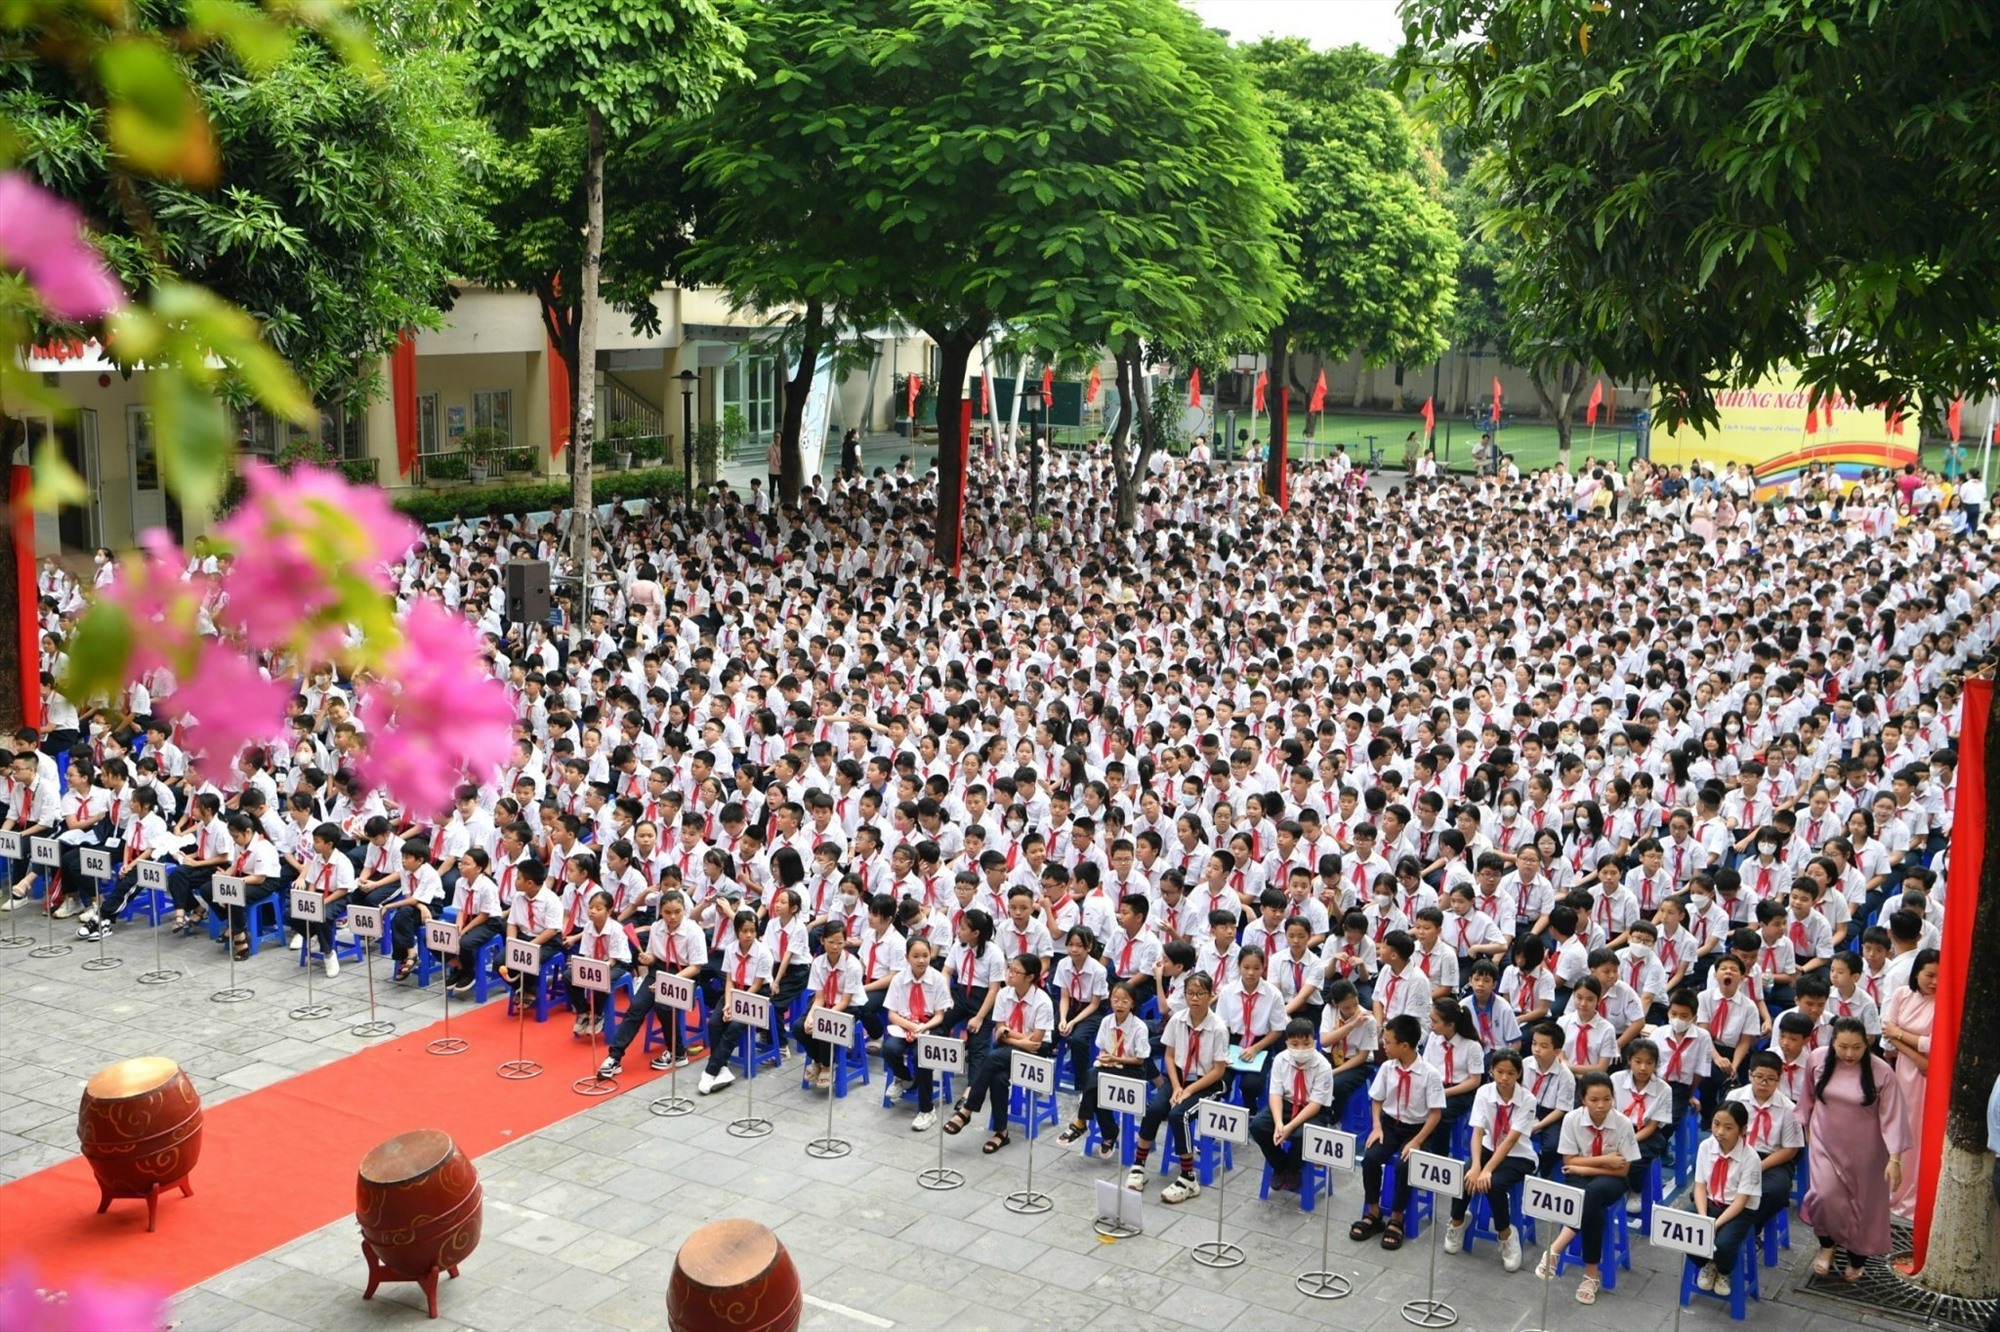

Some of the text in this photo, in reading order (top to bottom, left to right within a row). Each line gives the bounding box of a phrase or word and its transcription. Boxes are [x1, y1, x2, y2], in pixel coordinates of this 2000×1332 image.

[0, 838, 16, 850] 7A4
[37, 846, 53, 859] 6A1
[86, 857, 104, 870] 6A2
[143, 868, 160, 882] 6A3
[219, 883, 238, 898] 6A4
[297, 899, 316, 914] 6A5
[354, 914, 374, 928] 6A6
[432, 930, 452, 945] 6A7
[512, 949, 532, 966] 6A8
[579, 966, 601, 982] 6A9
[660, 982, 687, 1001] 6A10
[734, 1000, 764, 1019] 6A11
[817, 1018, 847, 1038] 6A12
[924, 1045, 958, 1063] 6A13
[1019, 1063, 1045, 1083] 7A5
[1107, 1086, 1135, 1105] 7A6
[1208, 1112, 1238, 1133] 7A7
[1313, 1137, 1344, 1159] 7A8
[1419, 1163, 1451, 1185] 7A9
[1531, 1190, 1574, 1216] 7A10
[1661, 1220, 1704, 1247] 7A11
